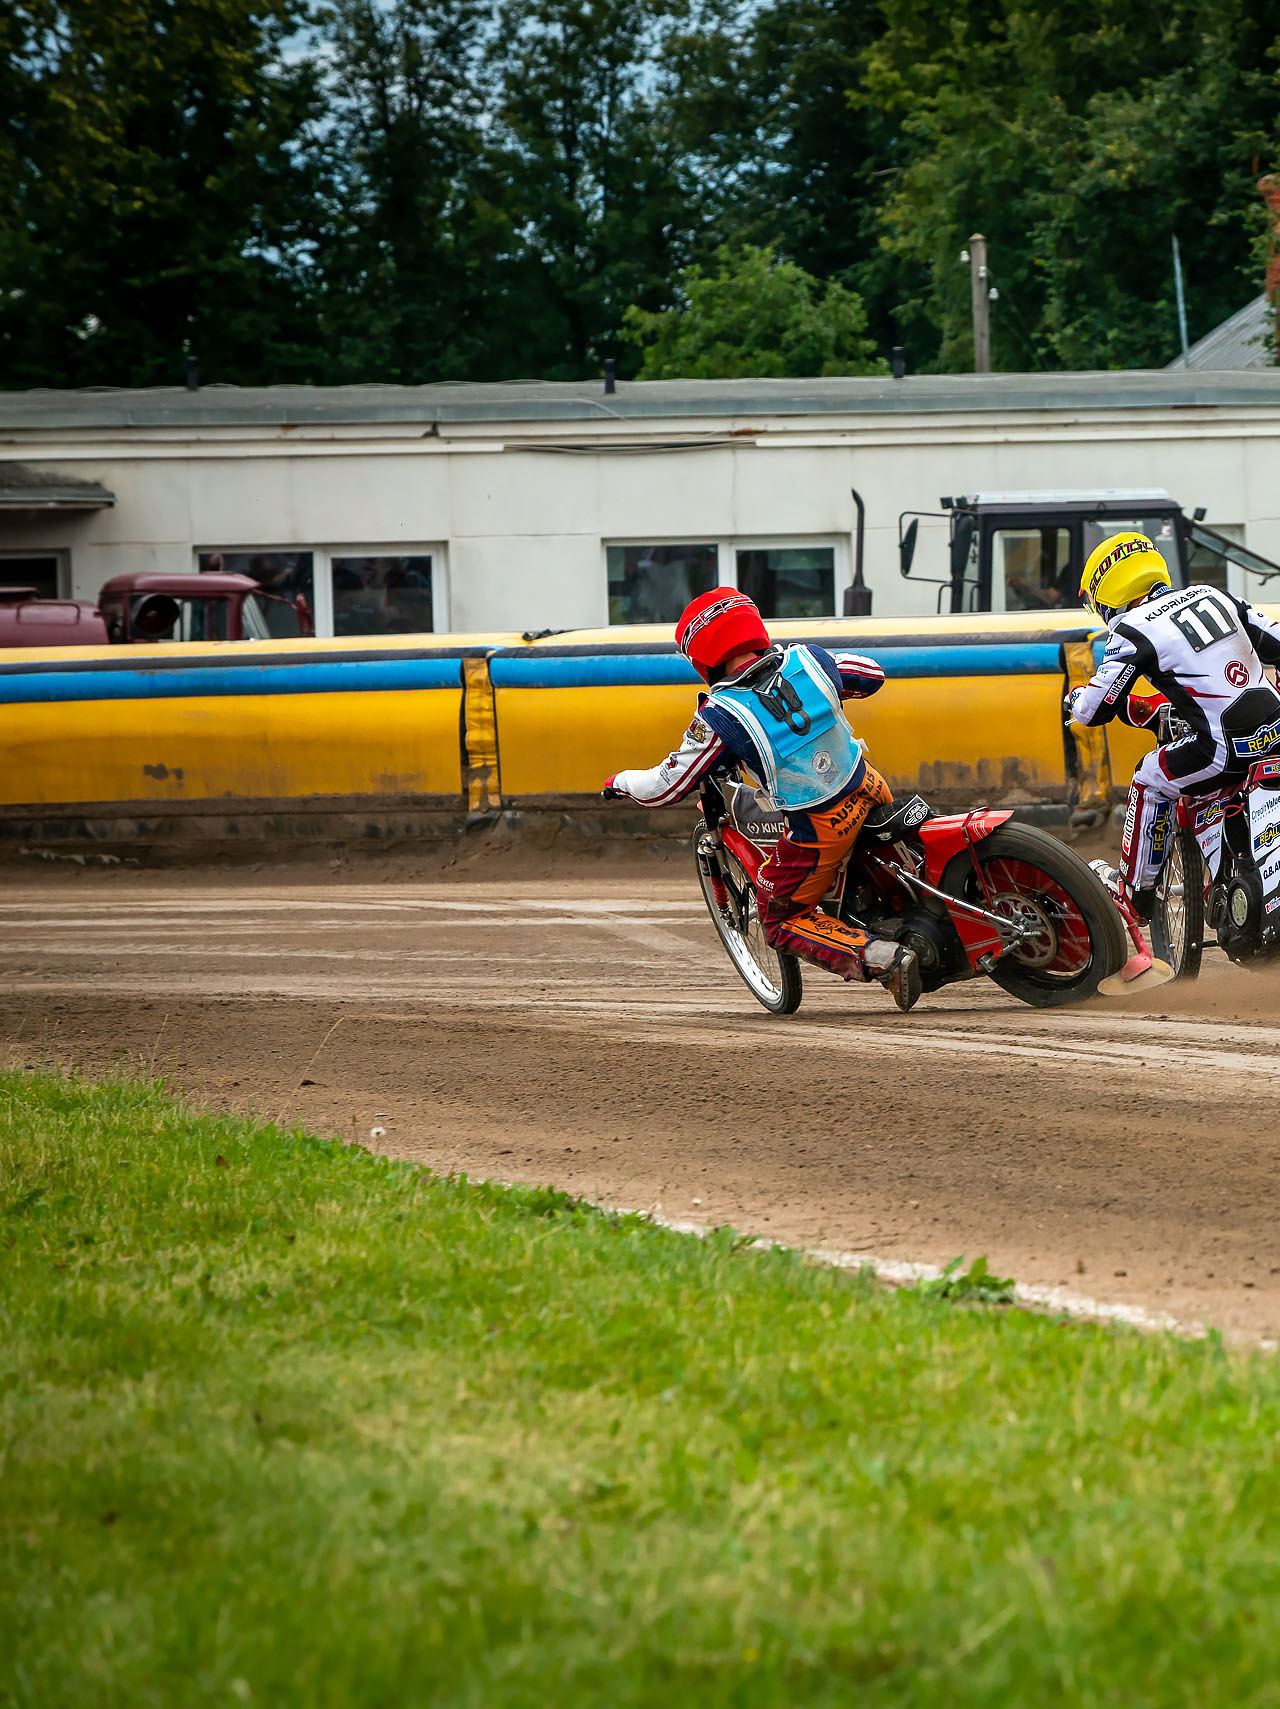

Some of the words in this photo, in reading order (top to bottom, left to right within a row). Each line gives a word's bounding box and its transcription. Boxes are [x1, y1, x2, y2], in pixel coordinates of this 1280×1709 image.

[1177, 598, 1232, 645] 11
[1248, 728, 1280, 752] REALL
[1154, 810, 1168, 851] REALL
[1260, 826, 1279, 845] REALL
